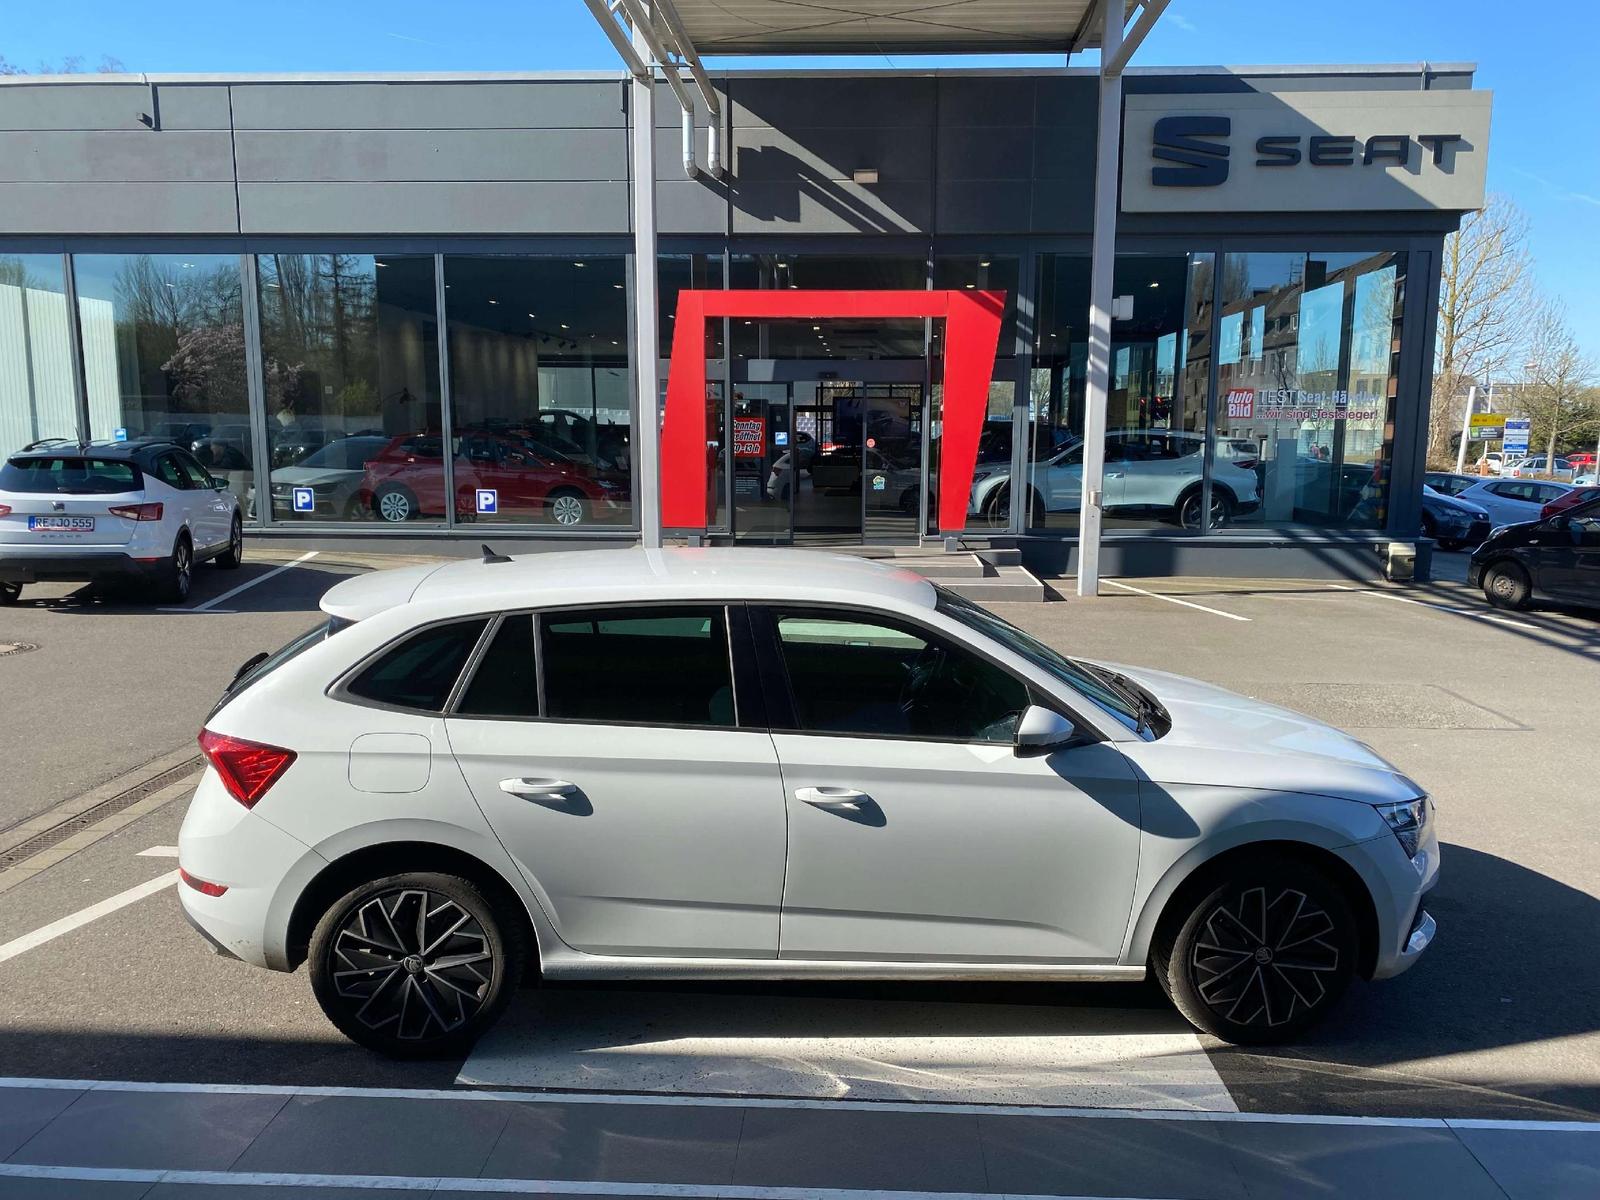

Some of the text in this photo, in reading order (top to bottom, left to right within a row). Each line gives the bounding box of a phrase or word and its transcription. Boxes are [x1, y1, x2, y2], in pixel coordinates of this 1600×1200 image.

[1255, 134, 1462, 166] SEAT
[1259, 390, 1296, 403] TEST
[1286, 408, 1310, 419] sind
[1315, 408, 1378, 421] Testsieger!
[35, 518, 49, 527] RE
[72, 518, 92, 528] 555
